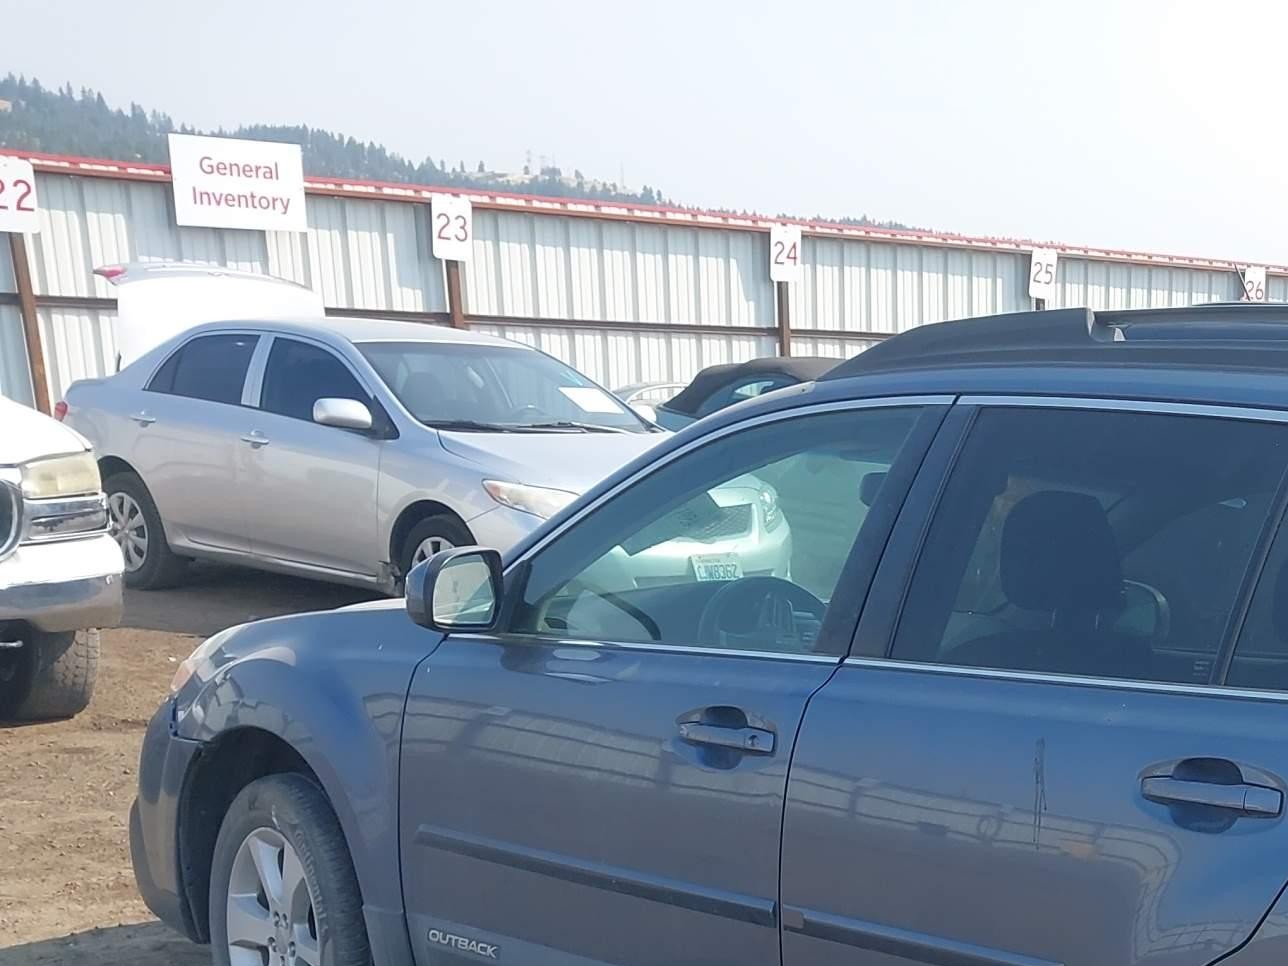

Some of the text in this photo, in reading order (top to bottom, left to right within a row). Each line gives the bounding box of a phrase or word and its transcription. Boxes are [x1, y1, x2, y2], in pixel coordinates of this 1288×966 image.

[199, 156, 280, 182] General
[191, 187, 291, 215] Inventory
[436, 213, 468, 242] 23
[774, 241, 798, 267] 24
[1032, 262, 1054, 285] 25
[1245, 280, 1264, 300] 26
[428, 929, 497, 958] OUTBACK
